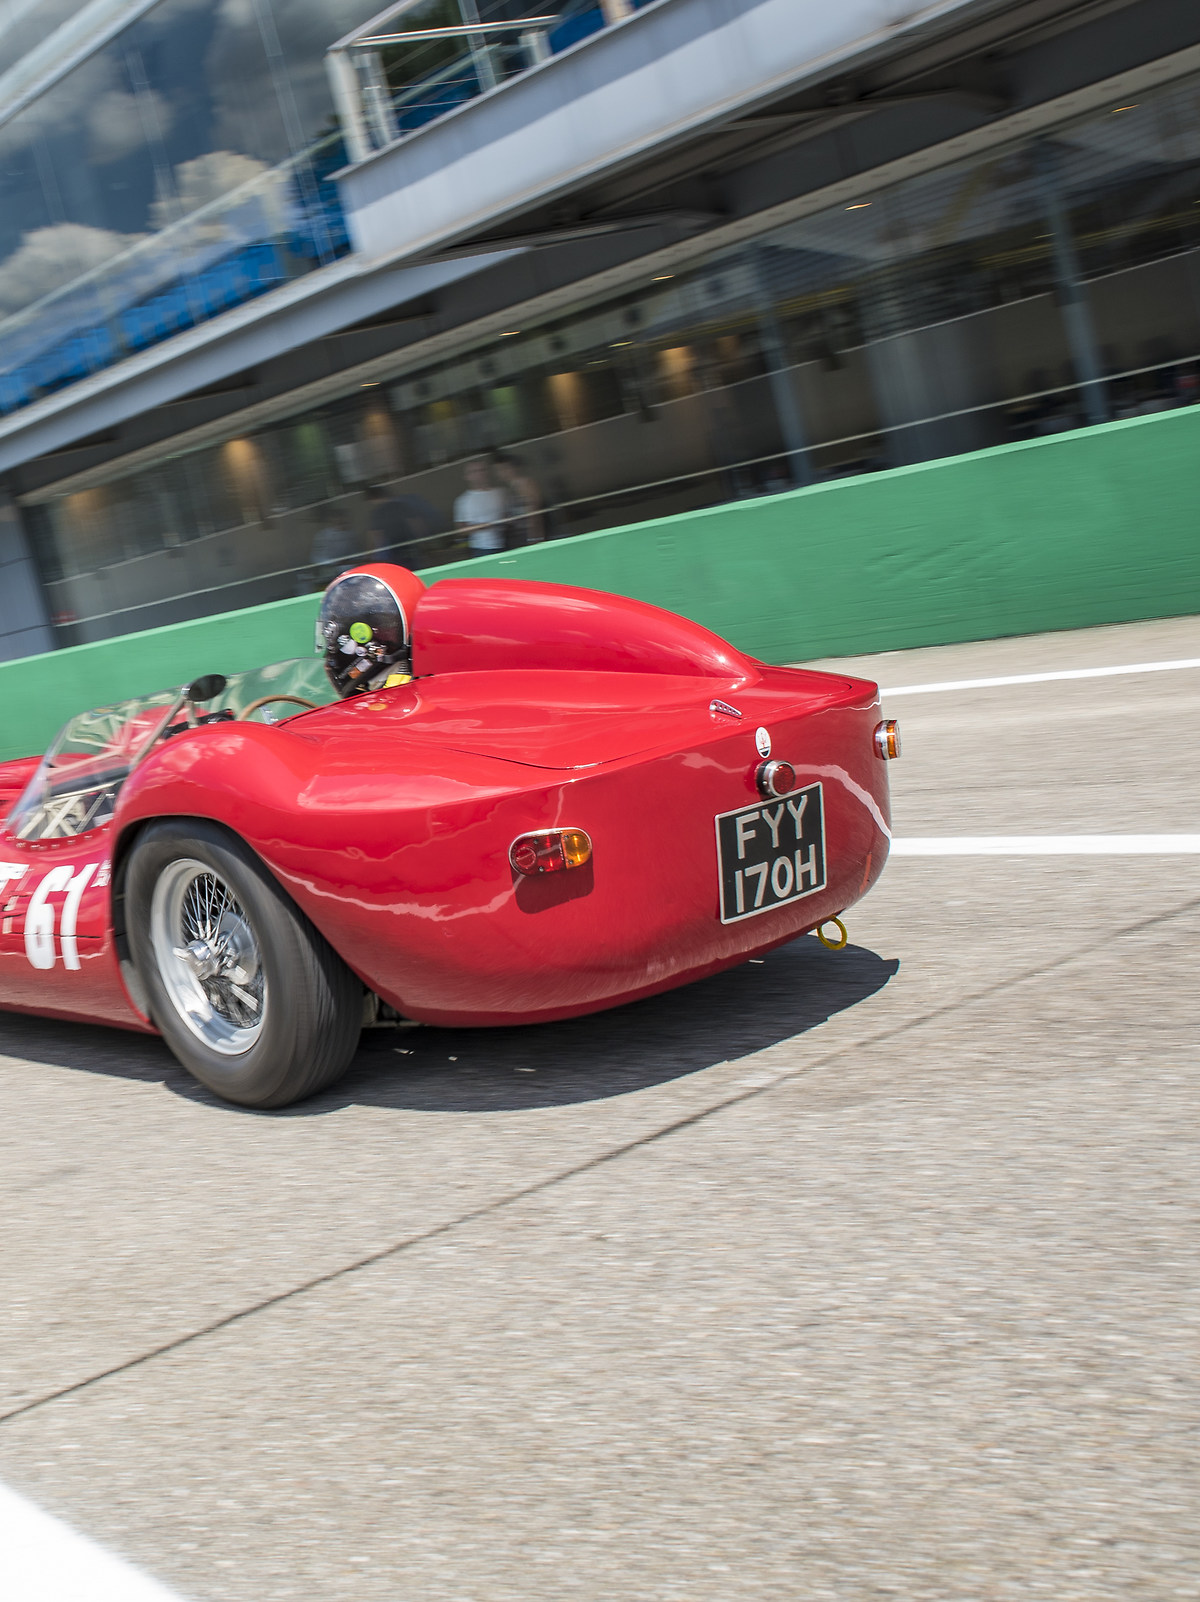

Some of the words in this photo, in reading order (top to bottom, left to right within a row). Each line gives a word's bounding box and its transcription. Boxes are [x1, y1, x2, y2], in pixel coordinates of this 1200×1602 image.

[735, 794, 808, 860] FYY
[734, 843, 817, 914] 170H
[24, 863, 99, 970] 61
